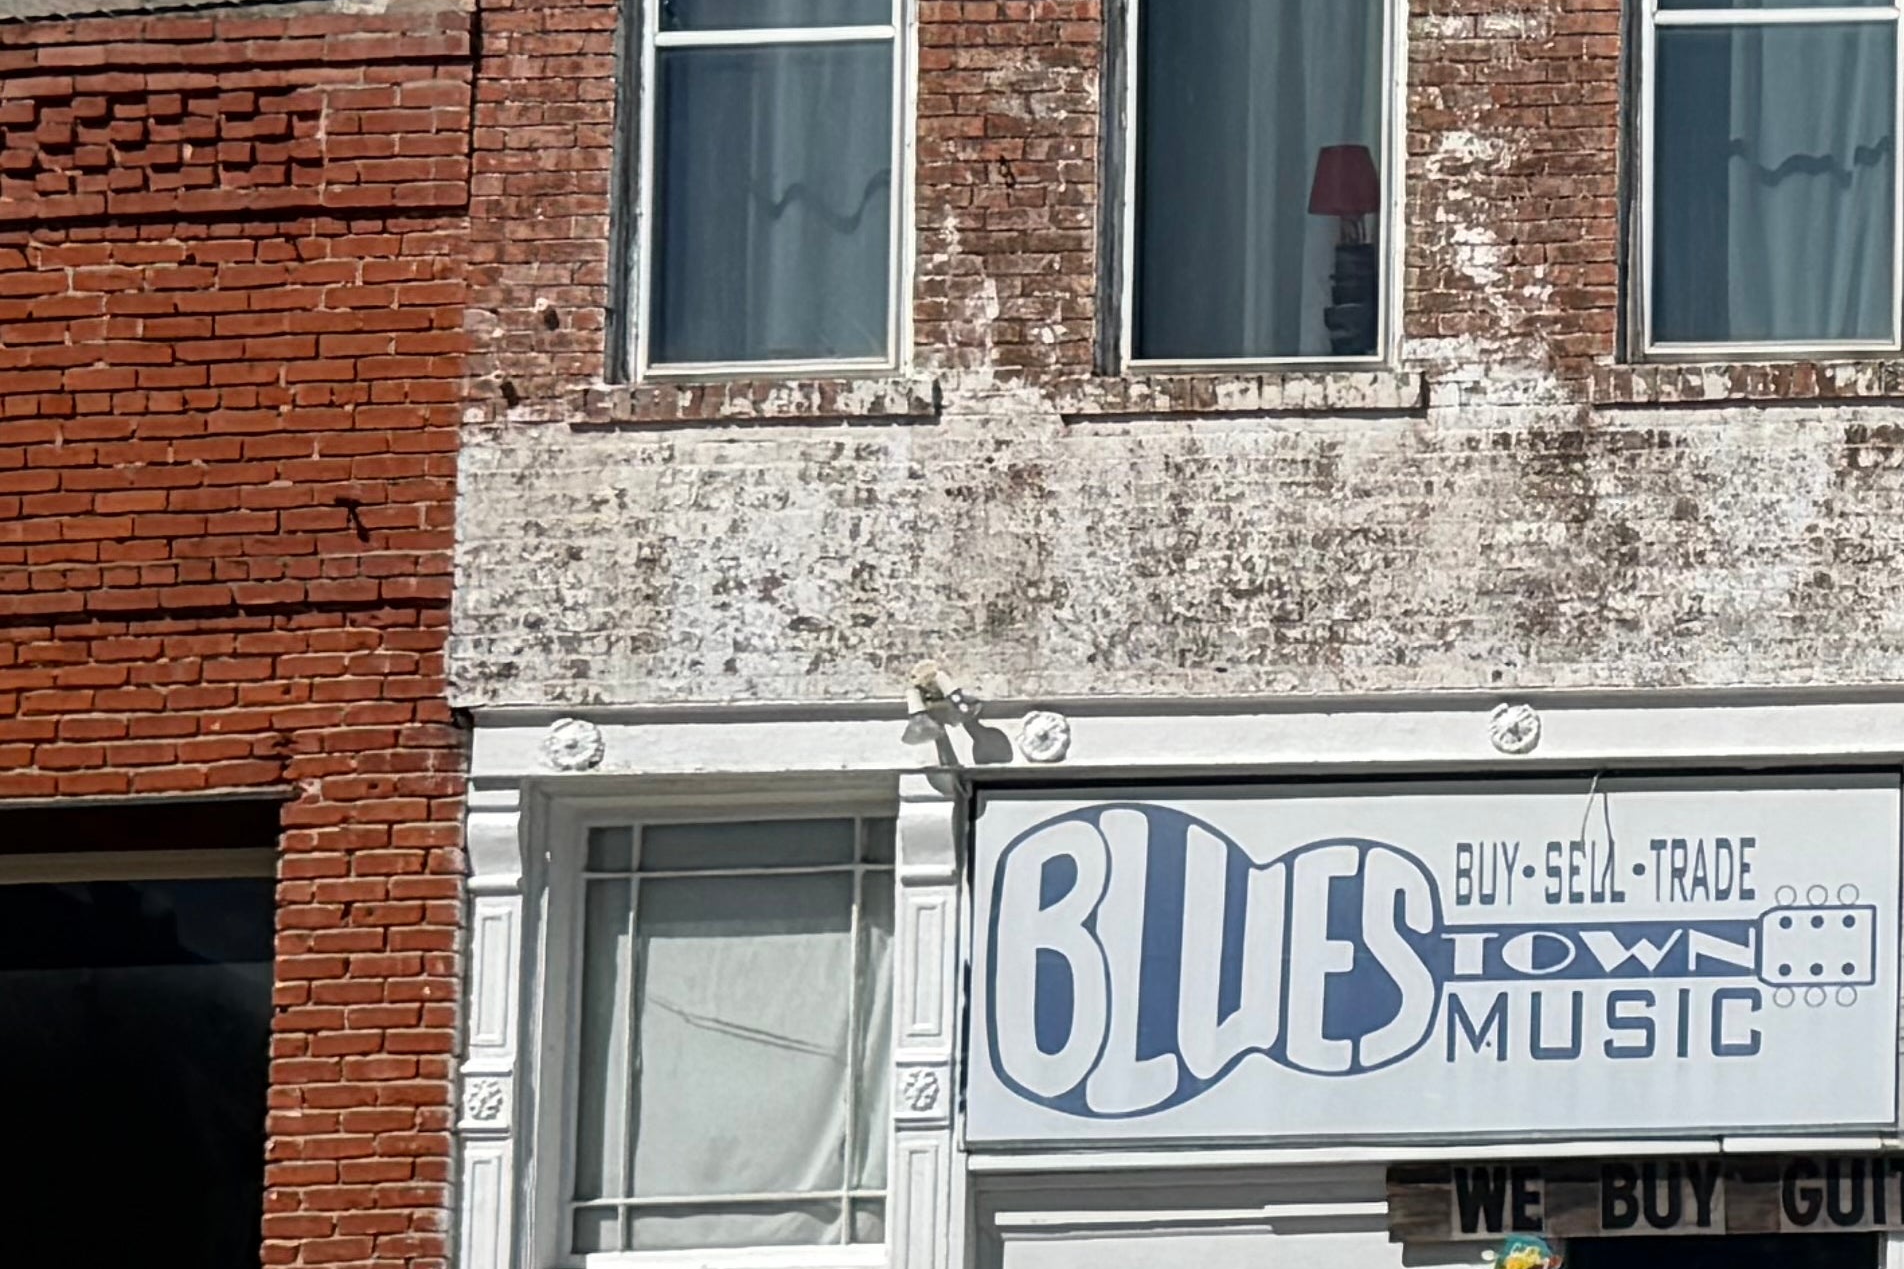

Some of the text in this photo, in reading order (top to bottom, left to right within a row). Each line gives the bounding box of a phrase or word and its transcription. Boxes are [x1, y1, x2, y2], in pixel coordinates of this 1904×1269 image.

[1455, 837, 1757, 906] BUY SELL TRADE
[995, 805, 1436, 1115] BLUES
[1440, 928, 1756, 976] TOWN
[1446, 987, 1763, 1063] MUSIC
[1453, 1165, 1545, 1234] WE
[1601, 1160, 1722, 1230] BUY
